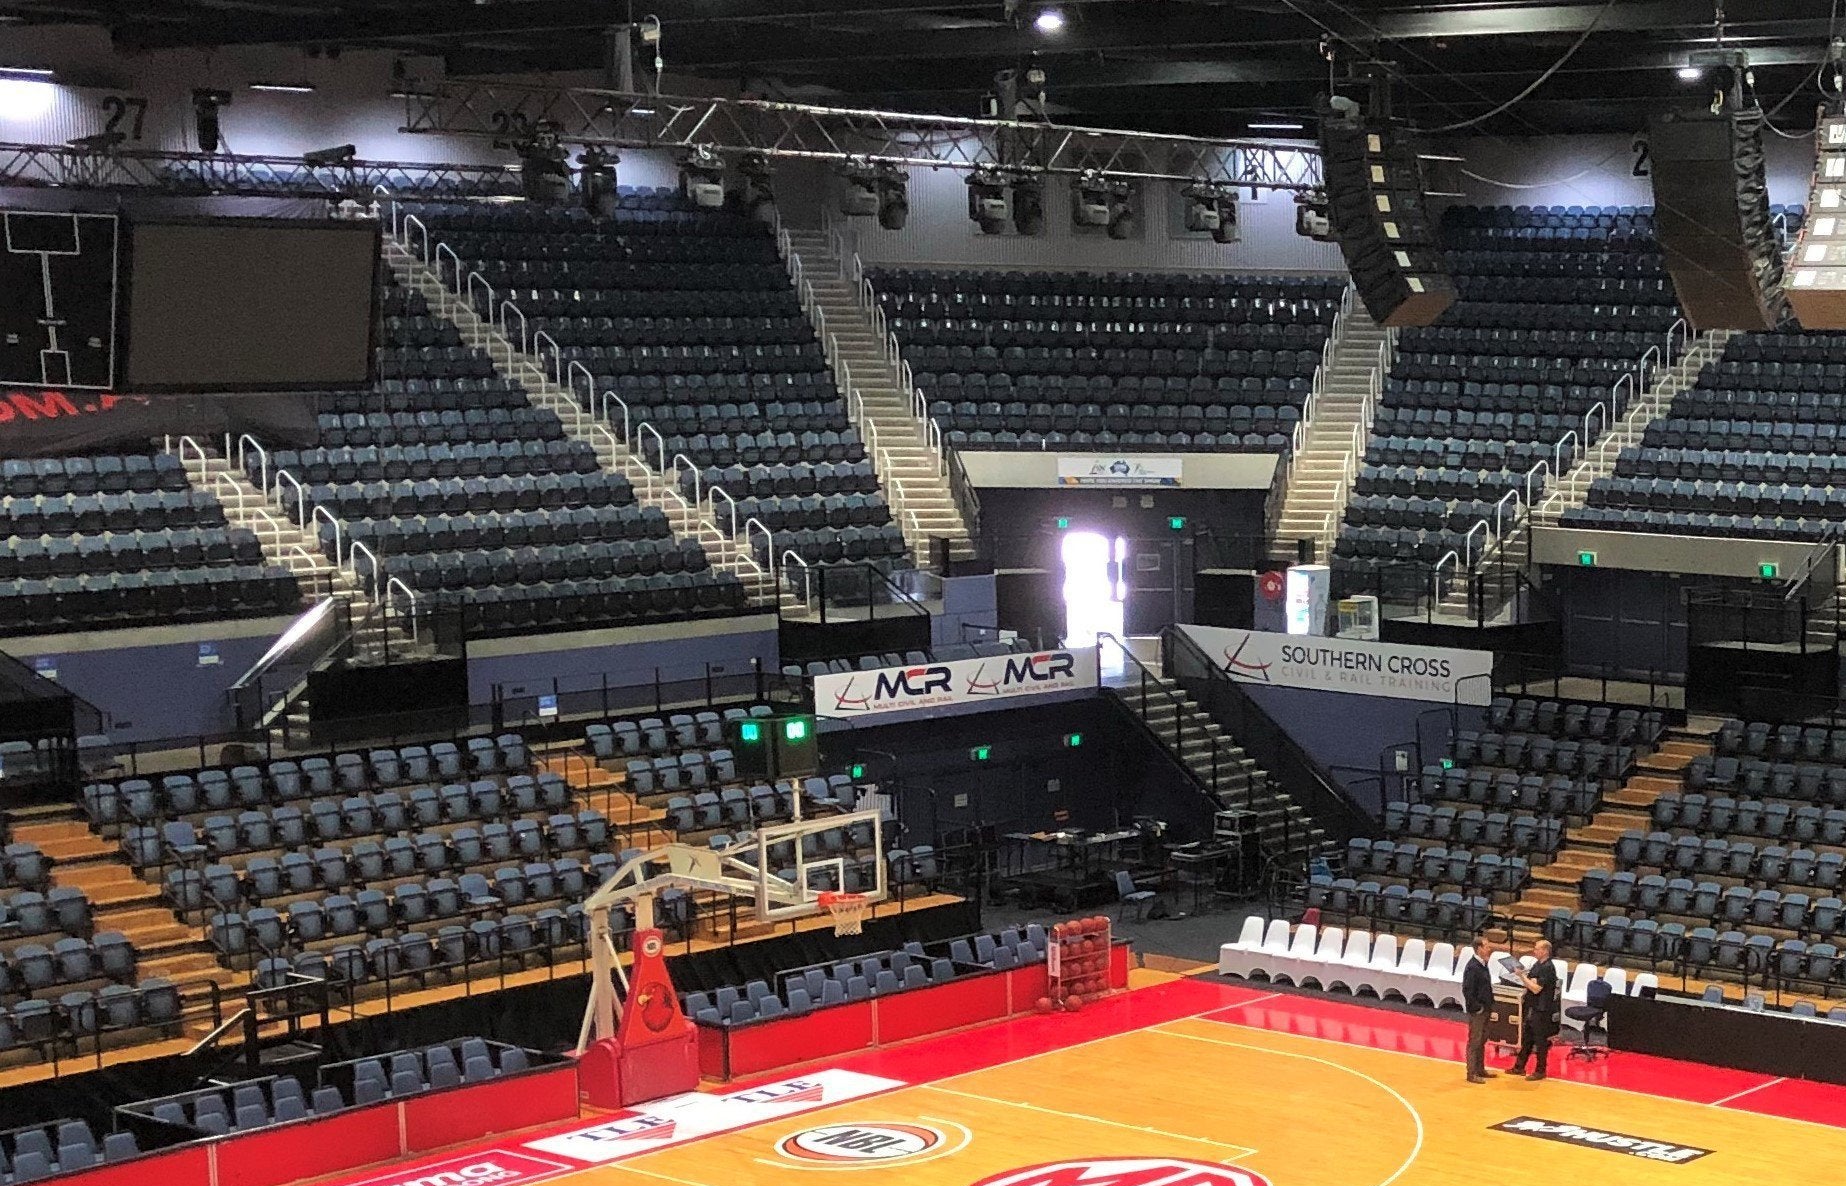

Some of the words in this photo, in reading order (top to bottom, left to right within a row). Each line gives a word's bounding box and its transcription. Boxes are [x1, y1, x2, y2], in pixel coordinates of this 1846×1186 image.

[102, 96, 148, 139] 27
[1632, 140, 1649, 176] 2
[1003, 652, 1075, 686] MCR
[1281, 645, 1382, 672] SOUTHERN
[1388, 655, 1451, 678] CROSS
[874, 666, 953, 700] MCR
[1280, 666, 1317, 680] CIVIL
[1340, 672, 1372, 684] RAIL
[1379, 675, 1452, 693] TRAINING
[720, 1080, 822, 1104] TLE
[566, 1116, 676, 1142] TLE
[811, 1129, 907, 1154] NBL
[1560, 1125, 1706, 1158] HUSTLE
